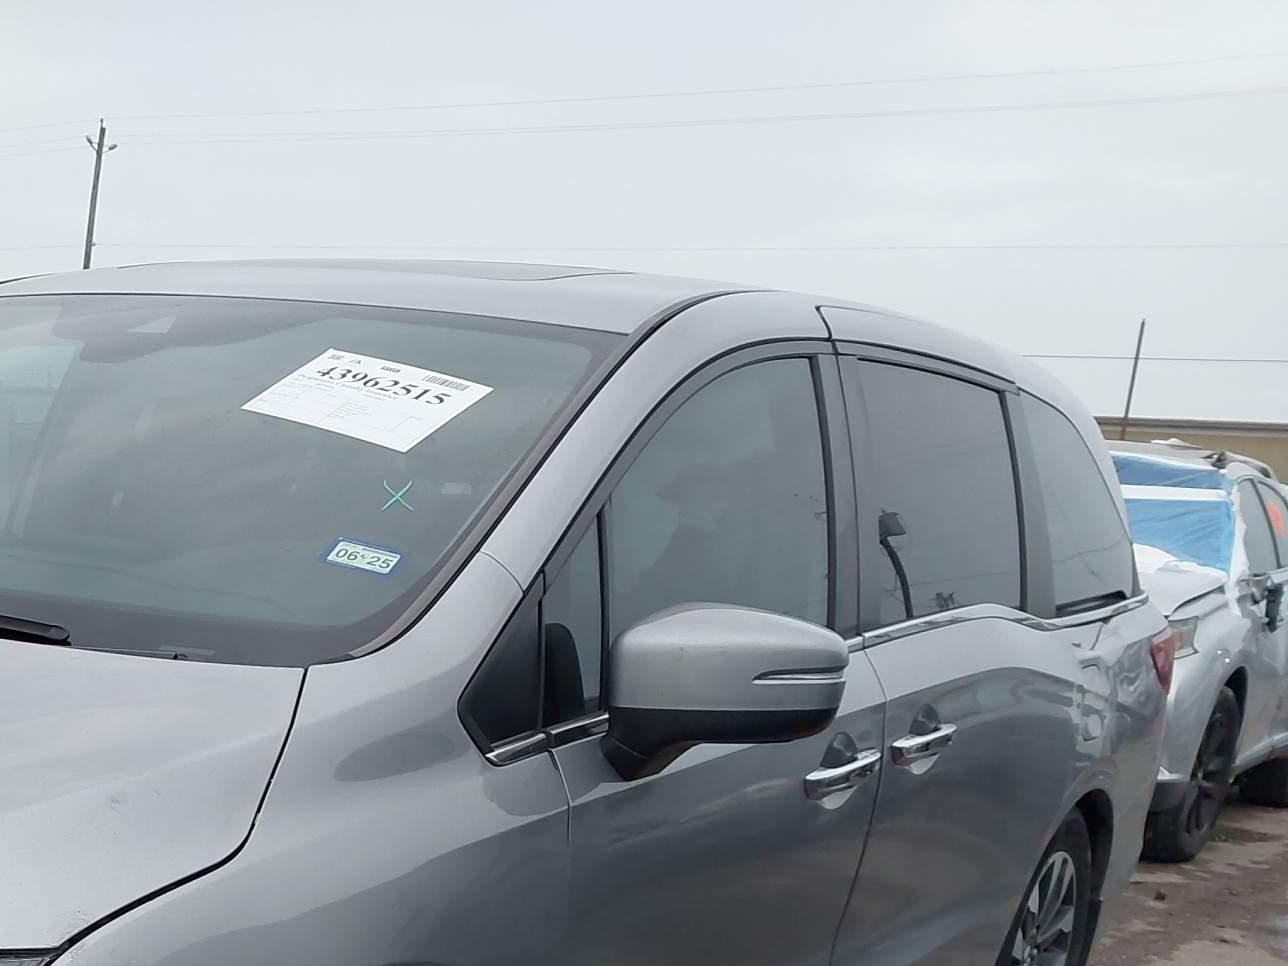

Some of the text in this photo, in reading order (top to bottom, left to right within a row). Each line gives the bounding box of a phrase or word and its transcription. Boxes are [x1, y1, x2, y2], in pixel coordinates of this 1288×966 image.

[316, 365, 452, 405] 43962515
[335, 548, 360, 561] 06
[365, 555, 394, 569] 25
